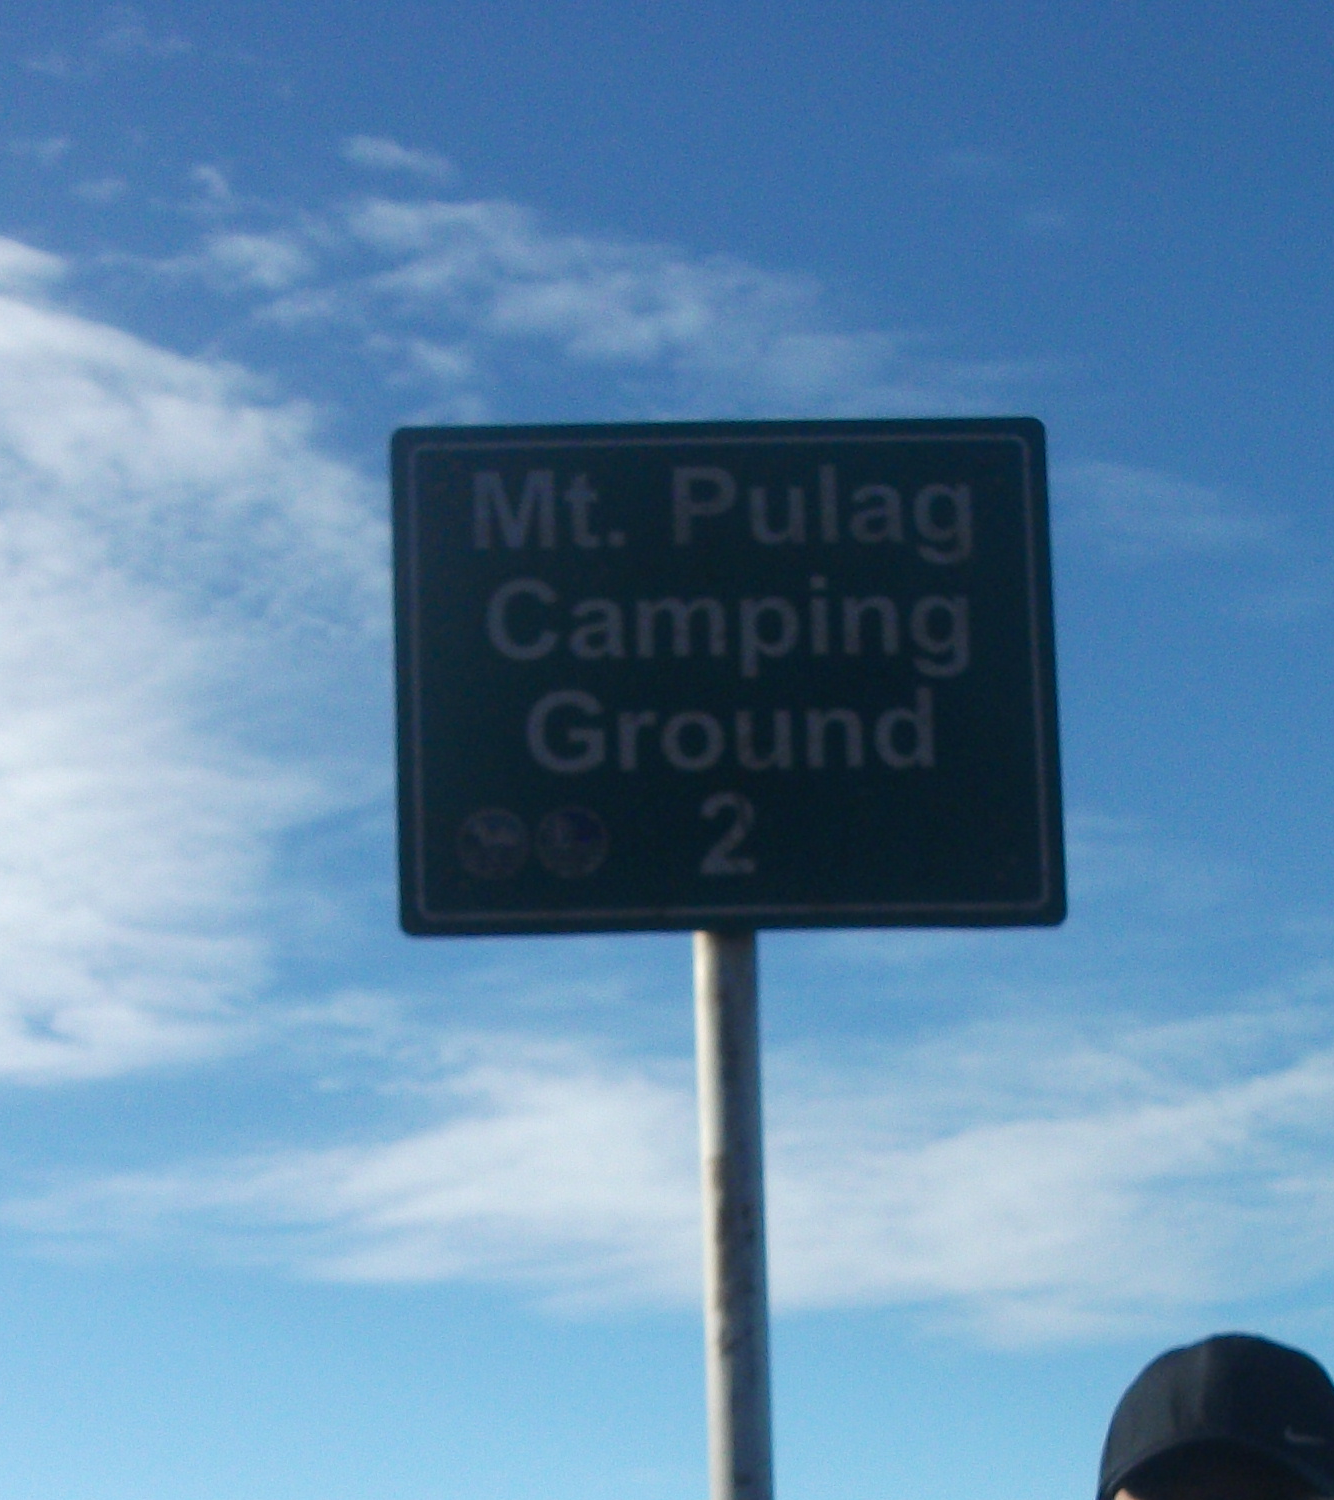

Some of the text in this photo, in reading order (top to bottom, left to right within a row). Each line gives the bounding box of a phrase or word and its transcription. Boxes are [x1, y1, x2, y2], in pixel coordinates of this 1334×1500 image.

[472, 465, 974, 565] Mt. Pulag
[485, 577, 973, 679] Camping
[526, 688, 936, 774] Ground
[699, 792, 757, 875] 2
